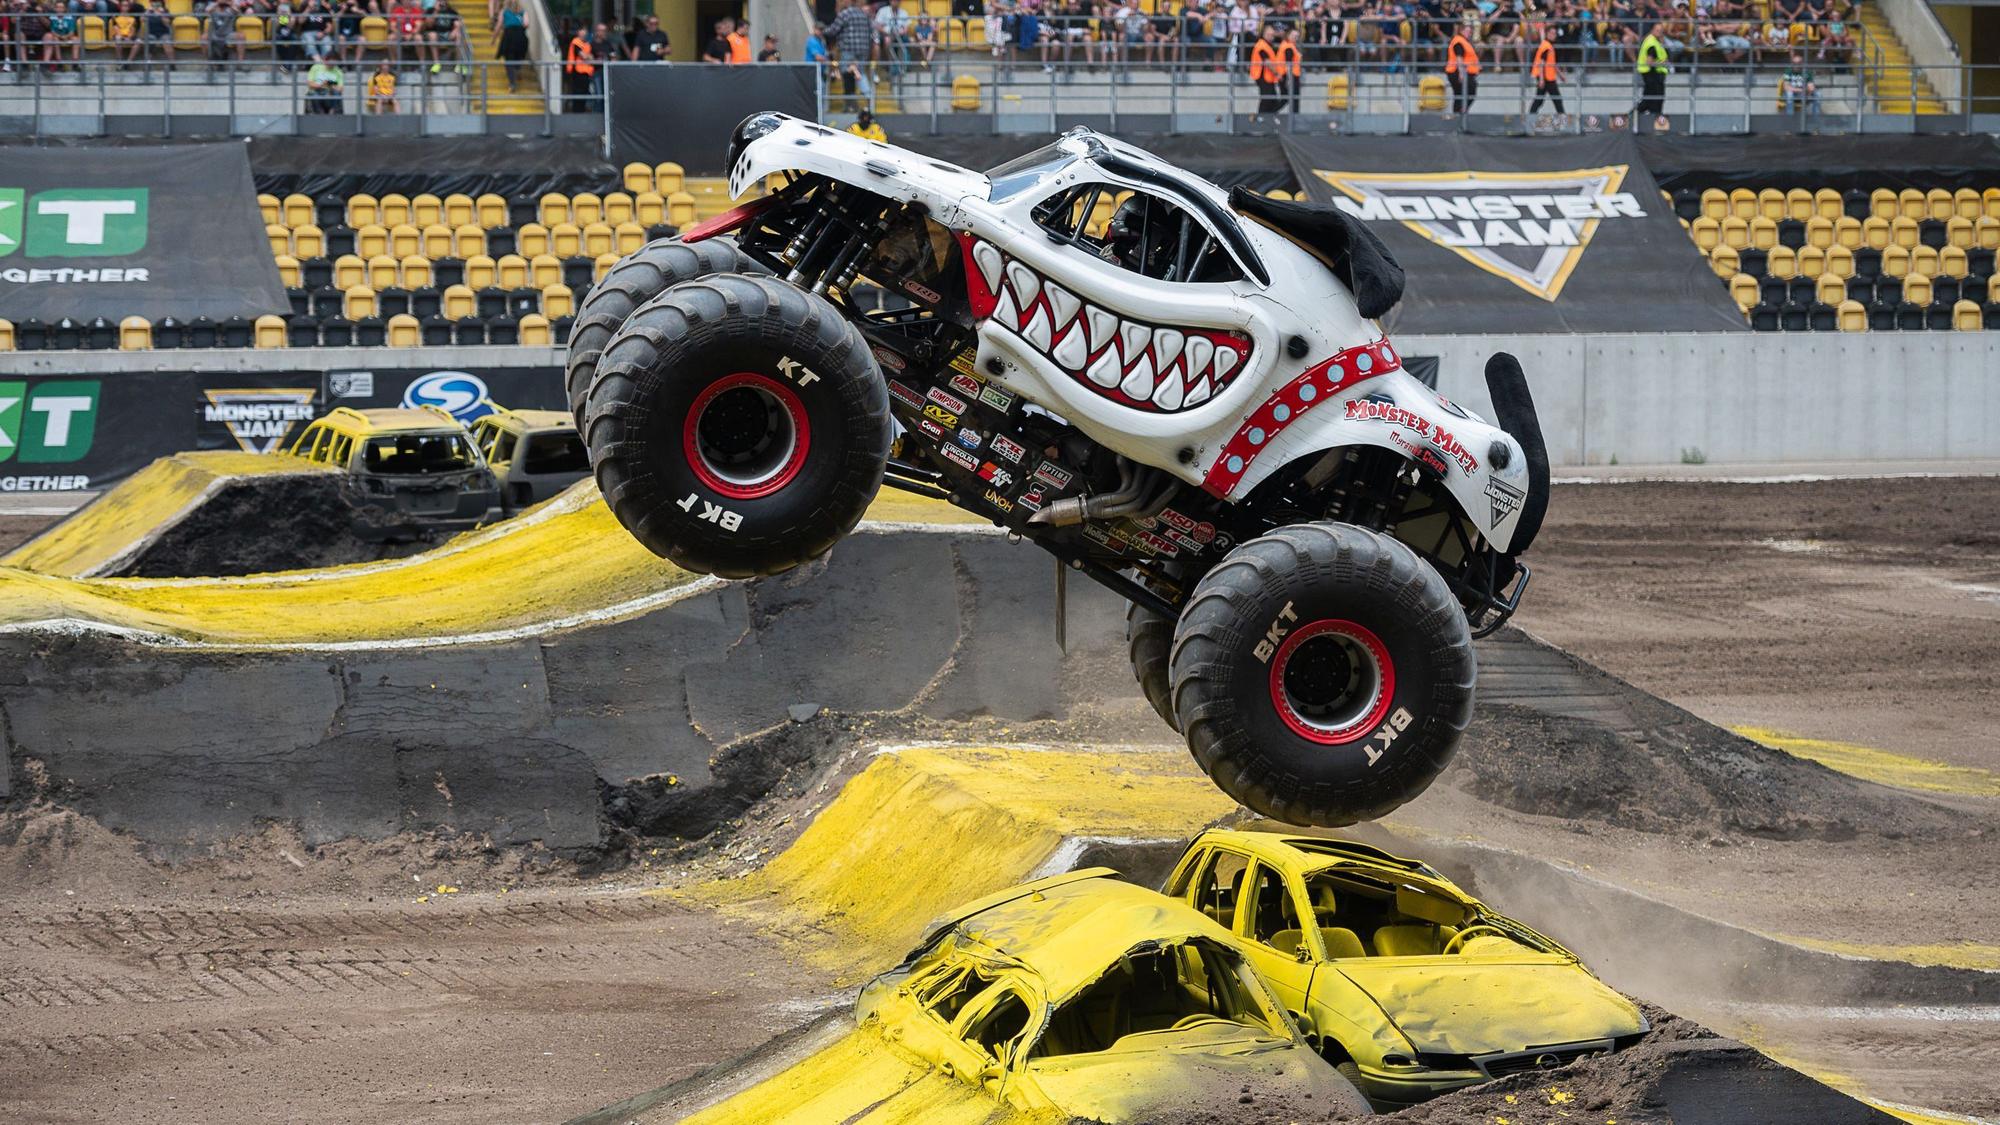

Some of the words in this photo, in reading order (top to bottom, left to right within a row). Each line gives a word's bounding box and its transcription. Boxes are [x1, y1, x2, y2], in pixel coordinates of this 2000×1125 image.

[1332, 192, 1648, 222] MONSTER
[1447, 218, 1580, 247] JAM
[0, 268, 149, 283] GETHER
[776, 355, 821, 387] KT
[930, 389, 963, 412] SIMPSON
[984, 390, 1009, 407] BKT
[205, 404, 314, 422] MONSTER
[235, 420, 285, 438] JAM
[921, 420, 941, 436] Coan
[1344, 399, 1431, 437] MONSTER
[1431, 424, 1479, 474] MUTT
[945, 444, 974, 463] LINCOLN
[0, 474, 90, 491] GETHER
[1041, 464, 1068, 482] OPTIMA
[985, 488, 1014, 512] UNOH
[1484, 484, 1521, 510] MONSTER
[1492, 499, 1511, 514] JAM
[676, 492, 744, 532] BKT
[1160, 509, 1195, 529] MSD
[1083, 525, 1110, 545] Holley
[1136, 530, 1179, 554] ARP
[1179, 536, 1202, 552] KING
[1252, 601, 1299, 664] BKT
[1363, 706, 1415, 767] BKT
